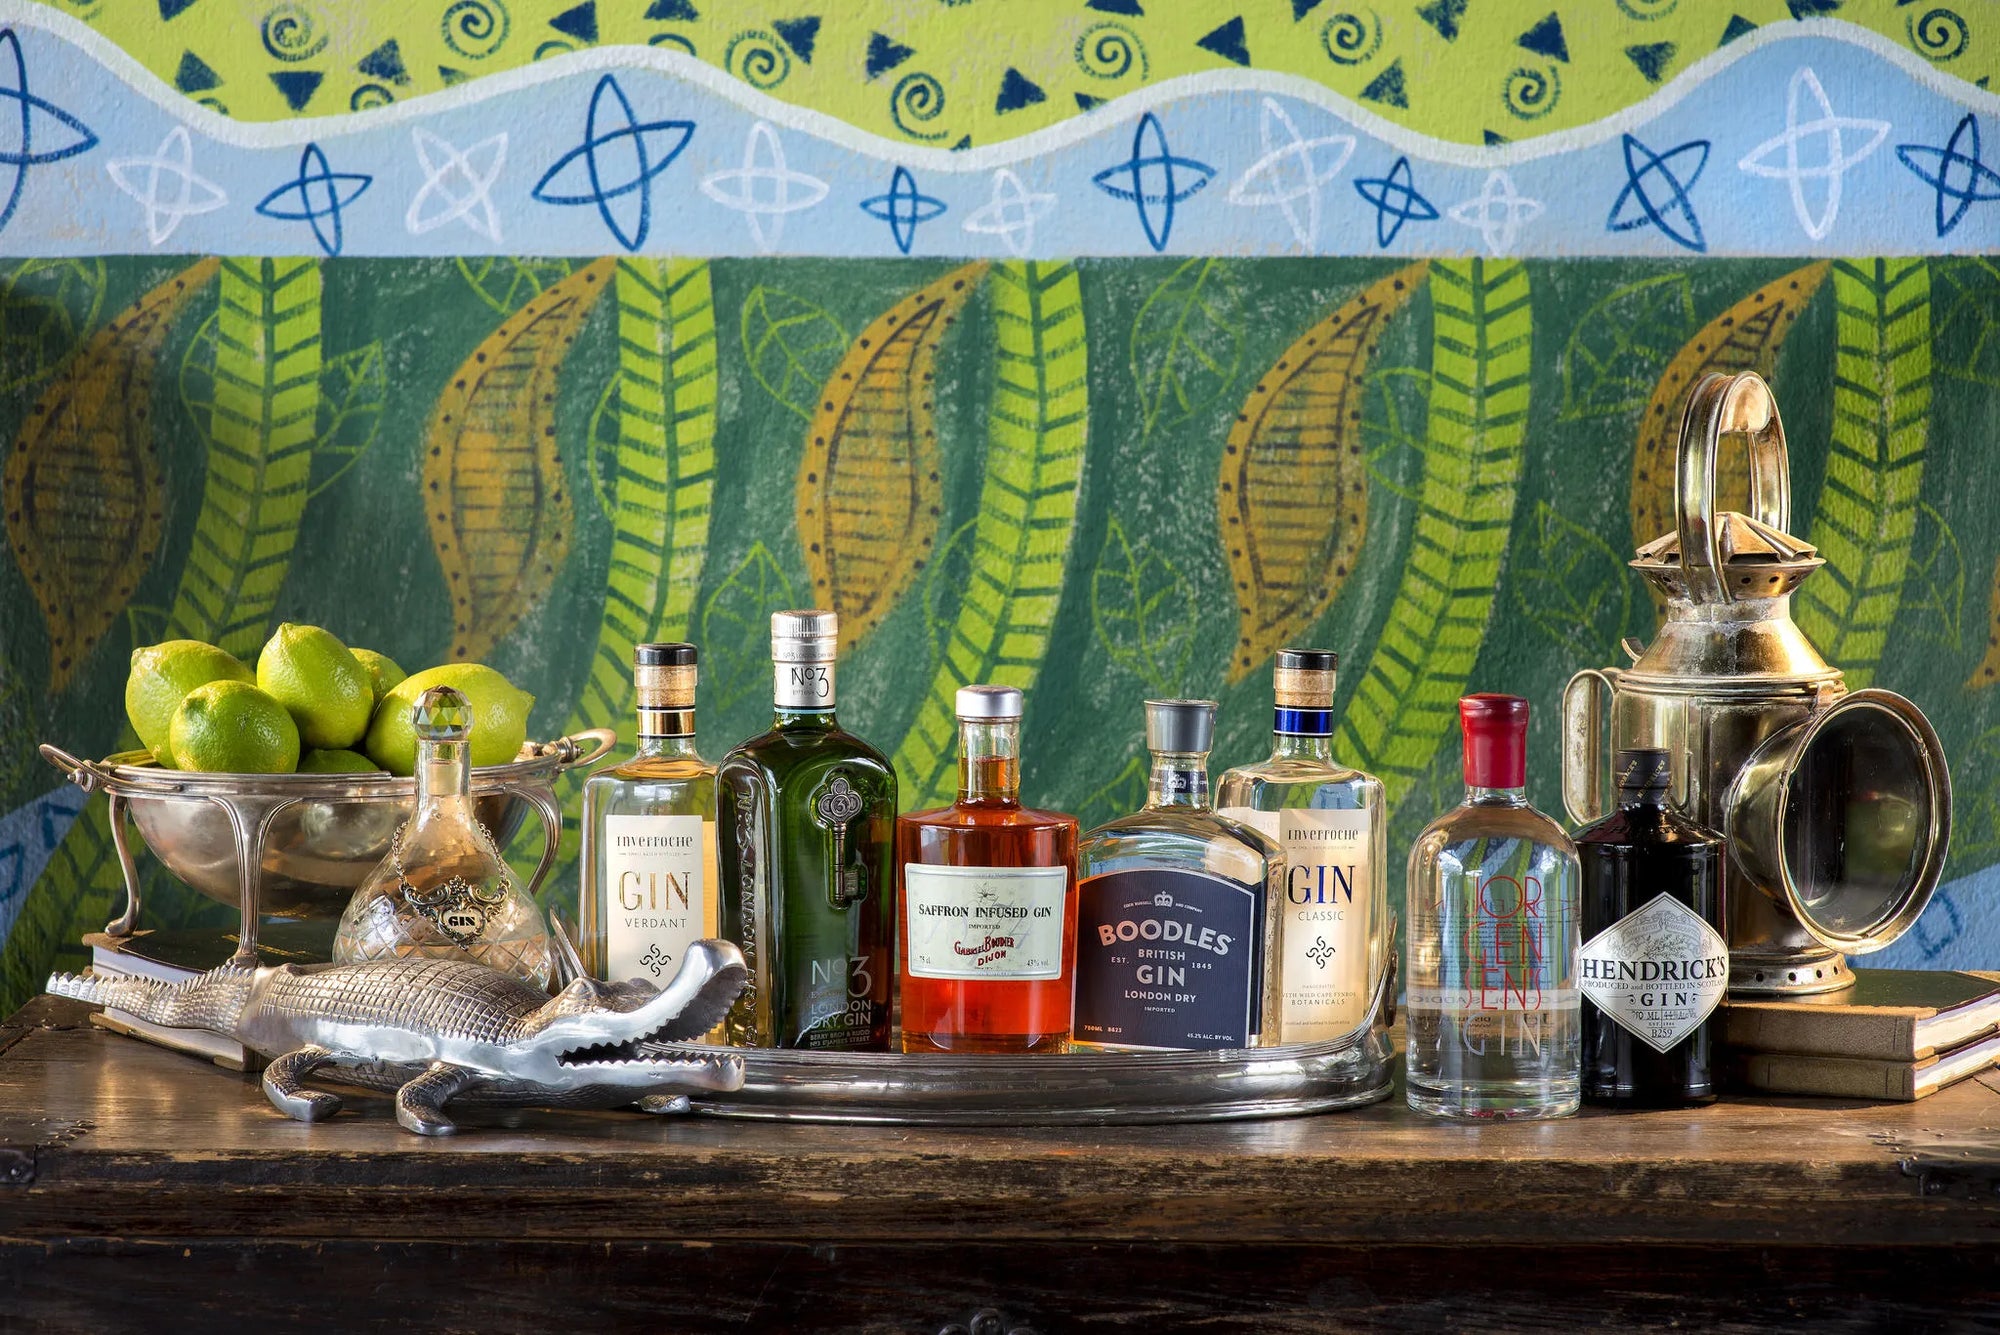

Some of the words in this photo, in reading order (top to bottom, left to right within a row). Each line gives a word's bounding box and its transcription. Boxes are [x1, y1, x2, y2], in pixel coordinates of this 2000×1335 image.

[619, 871, 691, 911] GIN
[1287, 865, 1356, 905] GIN
[1464, 875, 1542, 918] JOR
[919, 904, 969, 918] SAFFRON
[975, 906, 1028, 919] INFUSED
[1033, 906, 1052, 918] GIN
[1298, 911, 1344, 922] CLASSIC
[448, 916, 475, 926] GIN
[625, 918, 687, 928] VERDANT
[1098, 919, 1233, 956] BOODLES
[1464, 922, 1542, 965] GEN
[977, 950, 1007, 967] DIJON
[1138, 949, 1186, 961] BRITISH
[1192, 962, 1212, 970] 1845
[1582, 956, 1725, 981] HENDRICK'S
[1136, 965, 1185, 987] GIN
[1465, 968, 1542, 1011] SEN'S
[1584, 981, 1629, 990] PRODUCED
[1645, 981, 1685, 991] BOTTLED
[1686, 980, 1696, 989] IN
[1125, 990, 1171, 1001] LONDON
[1175, 993, 1197, 1003] DRY
[1292, 998, 1345, 1006] BOTANICALS
[1641, 993, 1687, 1006] GIN
[811, 1000, 872, 1015] LONDON
[811, 1014, 841, 1029] DRY
[843, 1011, 871, 1026] GIN
[1463, 1012, 1541, 1057] GIN
[1651, 1028, 1673, 1038] B259
